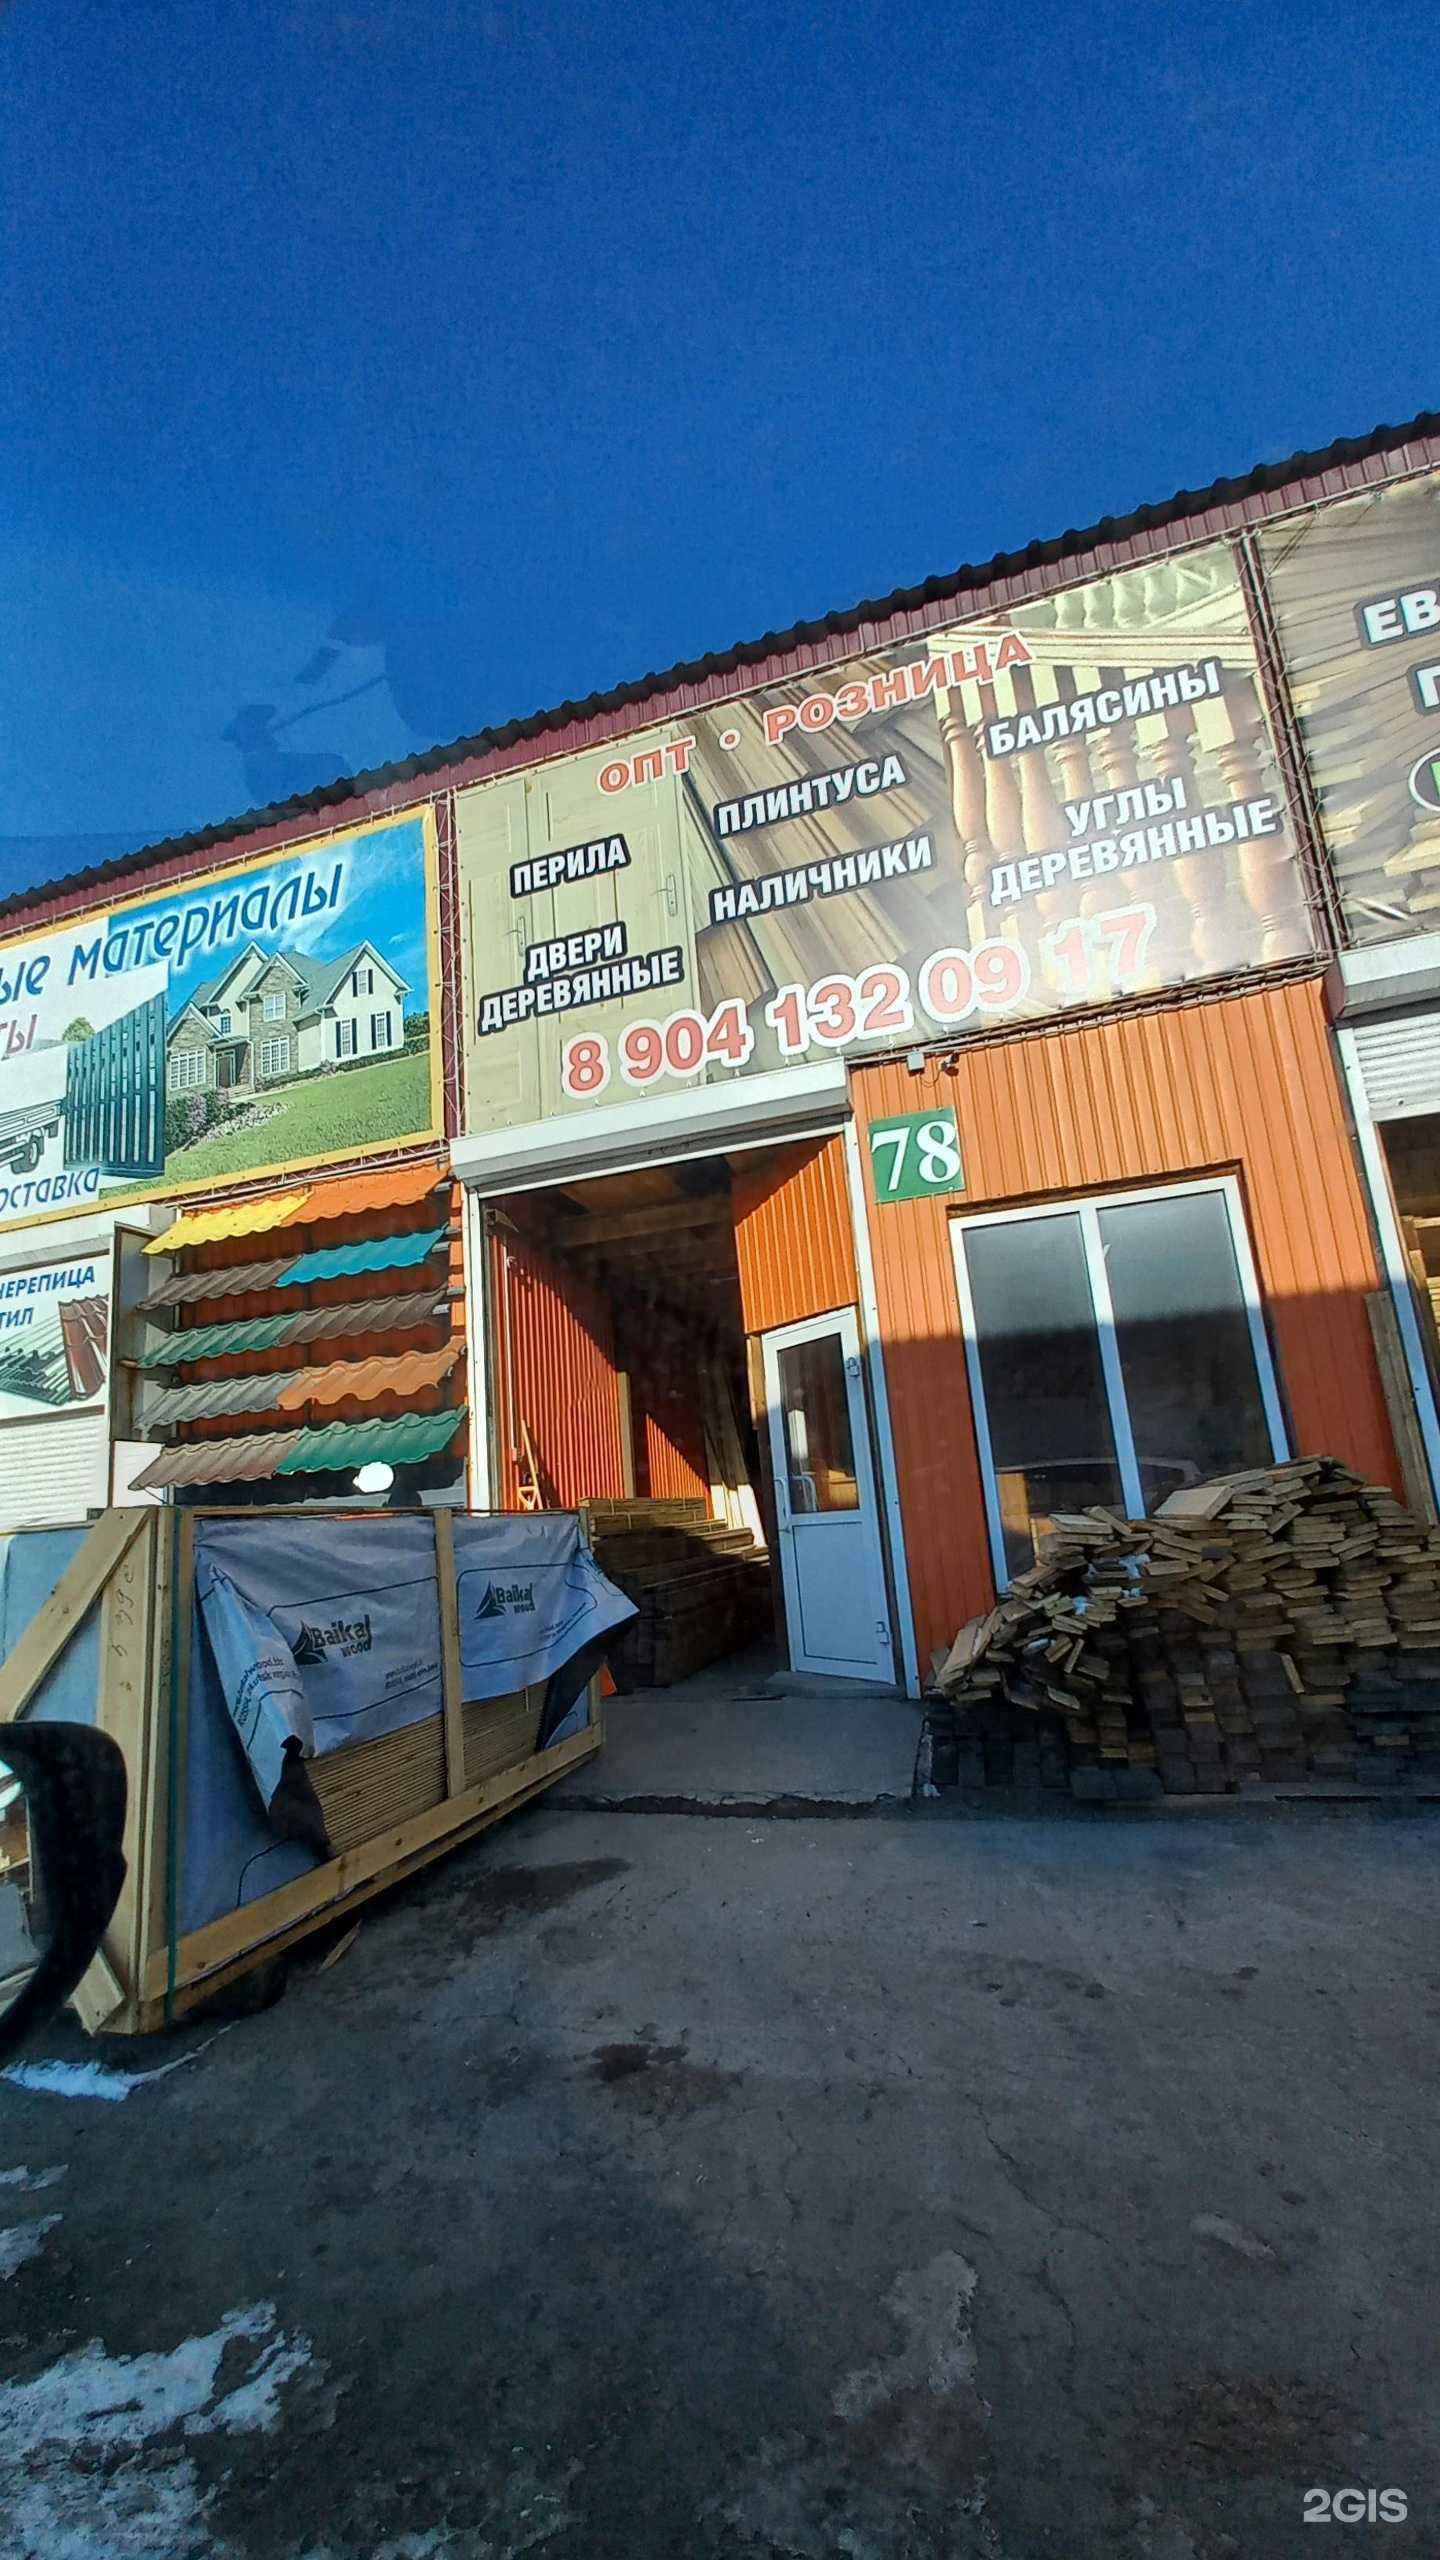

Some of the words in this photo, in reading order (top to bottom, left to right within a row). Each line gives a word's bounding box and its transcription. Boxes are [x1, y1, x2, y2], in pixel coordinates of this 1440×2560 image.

[599, 738, 694, 793] ОПТ
[765, 634, 1032, 743] РОЗНИЦА
[988, 662, 1221, 756] БАЛЯСИНЫ
[718, 756, 906, 835] ПЛИНТУСА
[1064, 775, 1187, 837] УГЛЫ
[512, 837, 628, 894] ПЕРИЛА
[713, 836, 932, 922] НАЛИЧНИКИ
[988, 799, 1279, 904] ДЕРЕВЯННЫЕ
[481, 951, 681, 1031] ДЕРЕВЯННЫЕ
[527, 926, 624, 981] ДВЕРИ
[566, 1039, 605, 1093] 8
[624, 1005, 748, 1081] 904
[771, 972, 905, 1051] 132
[930, 944, 1023, 1015] 09
[1053, 911, 1149, 987] 17
[870, 1119, 961, 1192] 78
[311, 1613, 372, 1649] Baikal
[495, 1583, 534, 1604] Baikal
[342, 1640, 372, 1658] wood
